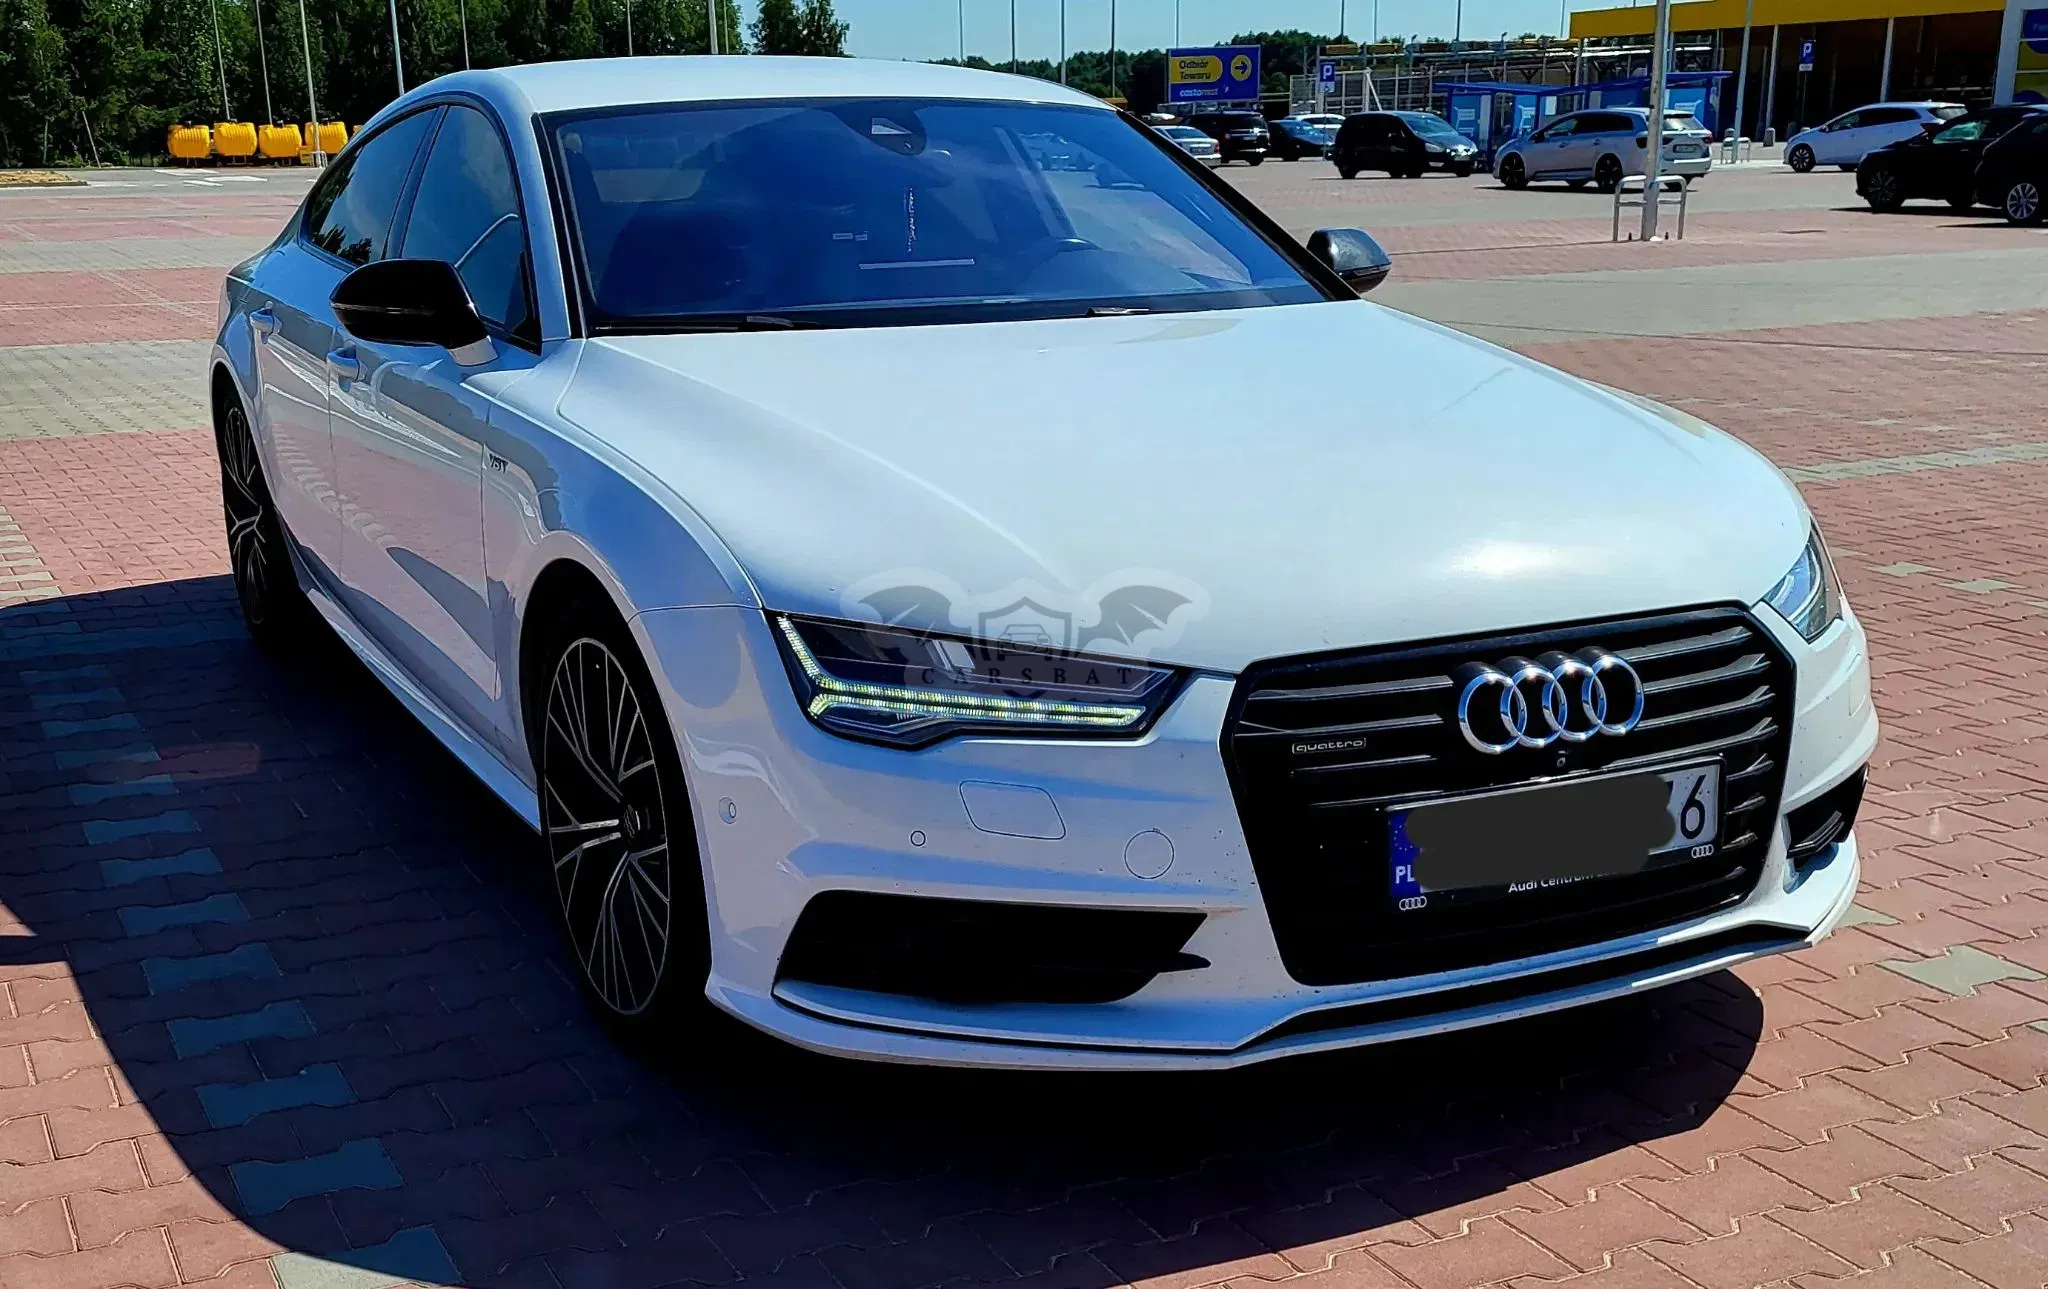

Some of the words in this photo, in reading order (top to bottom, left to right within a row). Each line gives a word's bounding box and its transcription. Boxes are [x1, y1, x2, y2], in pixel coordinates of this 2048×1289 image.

[1803, 43, 1812, 57] P
[1323, 65, 1332, 80] P
[1295, 739, 1363, 753] quattro
[1395, 864, 1416, 884] PL
[1508, 880, 1538, 893] Audi
